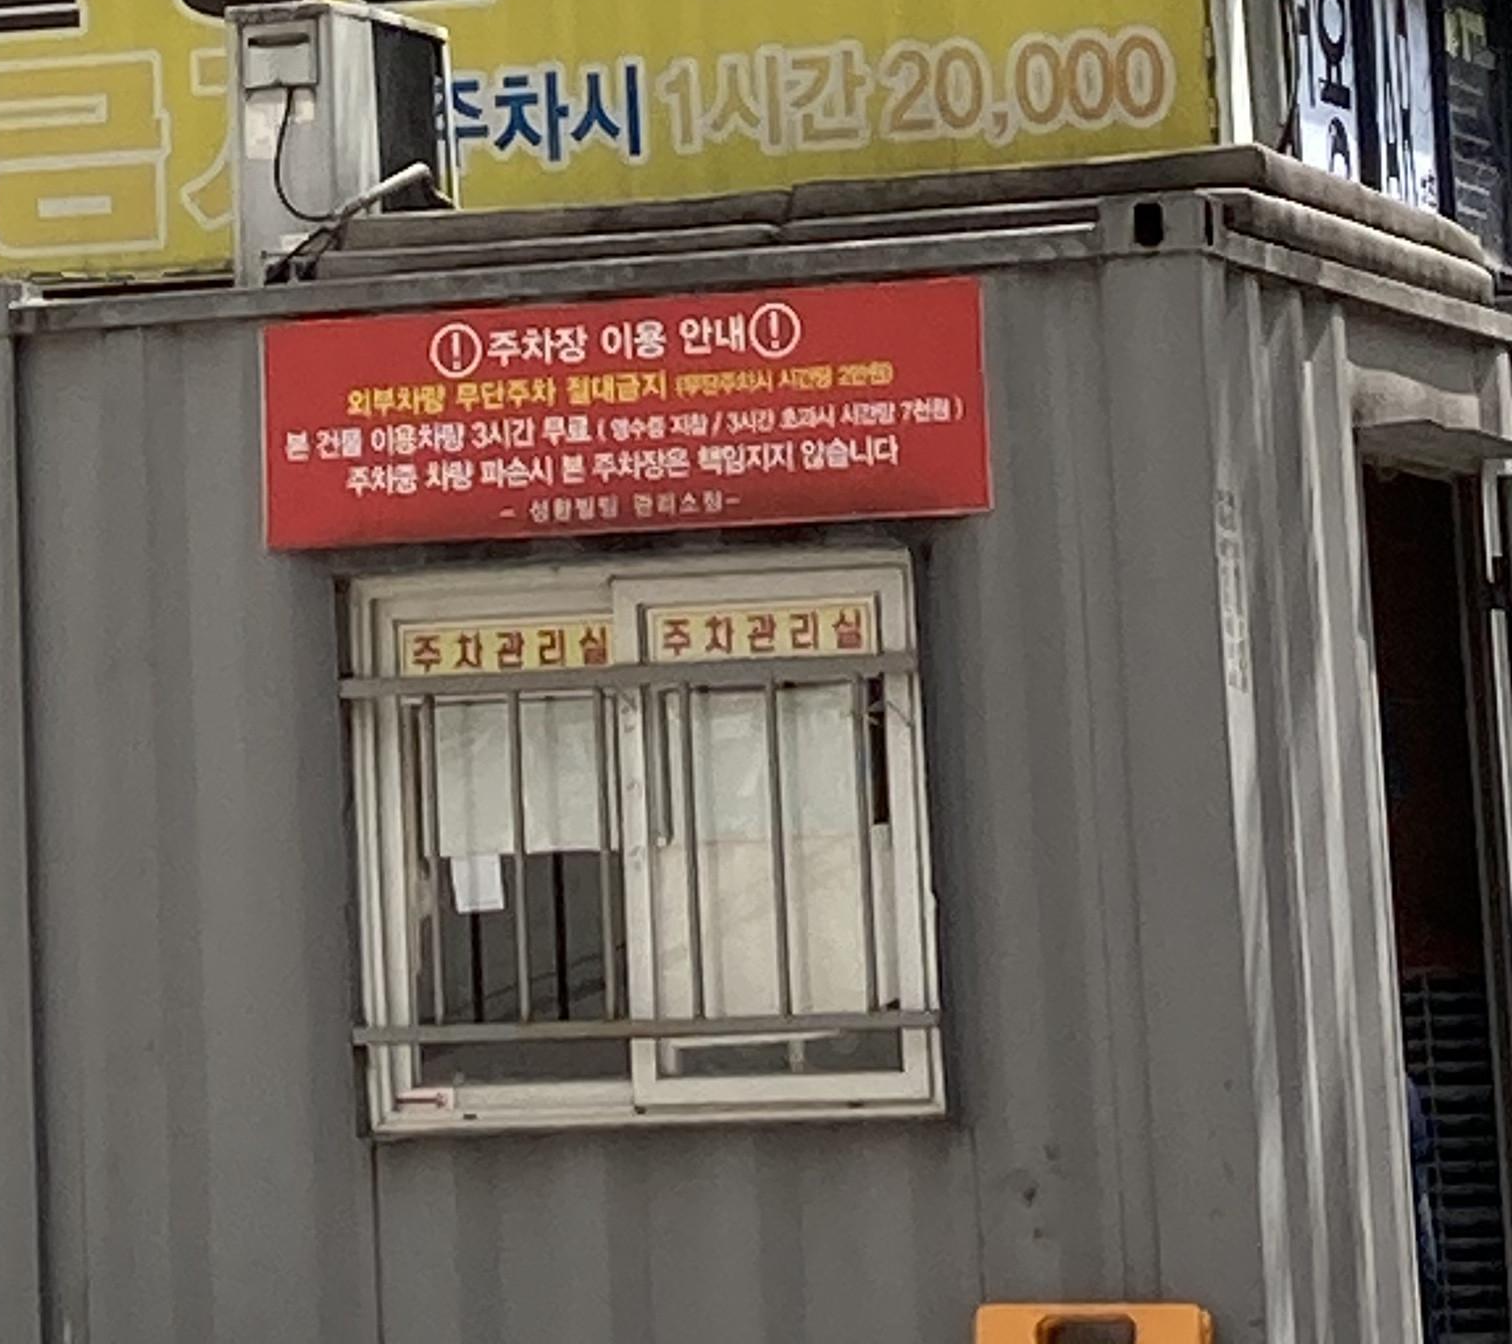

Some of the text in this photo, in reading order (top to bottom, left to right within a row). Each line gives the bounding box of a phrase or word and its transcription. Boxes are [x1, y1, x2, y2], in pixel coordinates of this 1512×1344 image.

[662, 42, 869, 152] 1시간
[887, 31, 1171, 143] 20,000
[487, 313, 746, 367] 주차장 이용 안내
[348, 383, 446, 417] 외부차량
[455, 377, 557, 411] 무단주차
[566, 369, 668, 405] 절대금지
[285, 430, 310, 462] 본
[315, 426, 363, 460] 건물
[369, 421, 465, 456] 이용차량
[471, 416, 535, 450] 3시간
[542, 414, 592, 445] 무료
[346, 433, 899, 498] 주차중 차량 파손시 본 주차장은 책임지지 않습니다
[413, 608, 865, 672] 주차관리실 주차관리실
